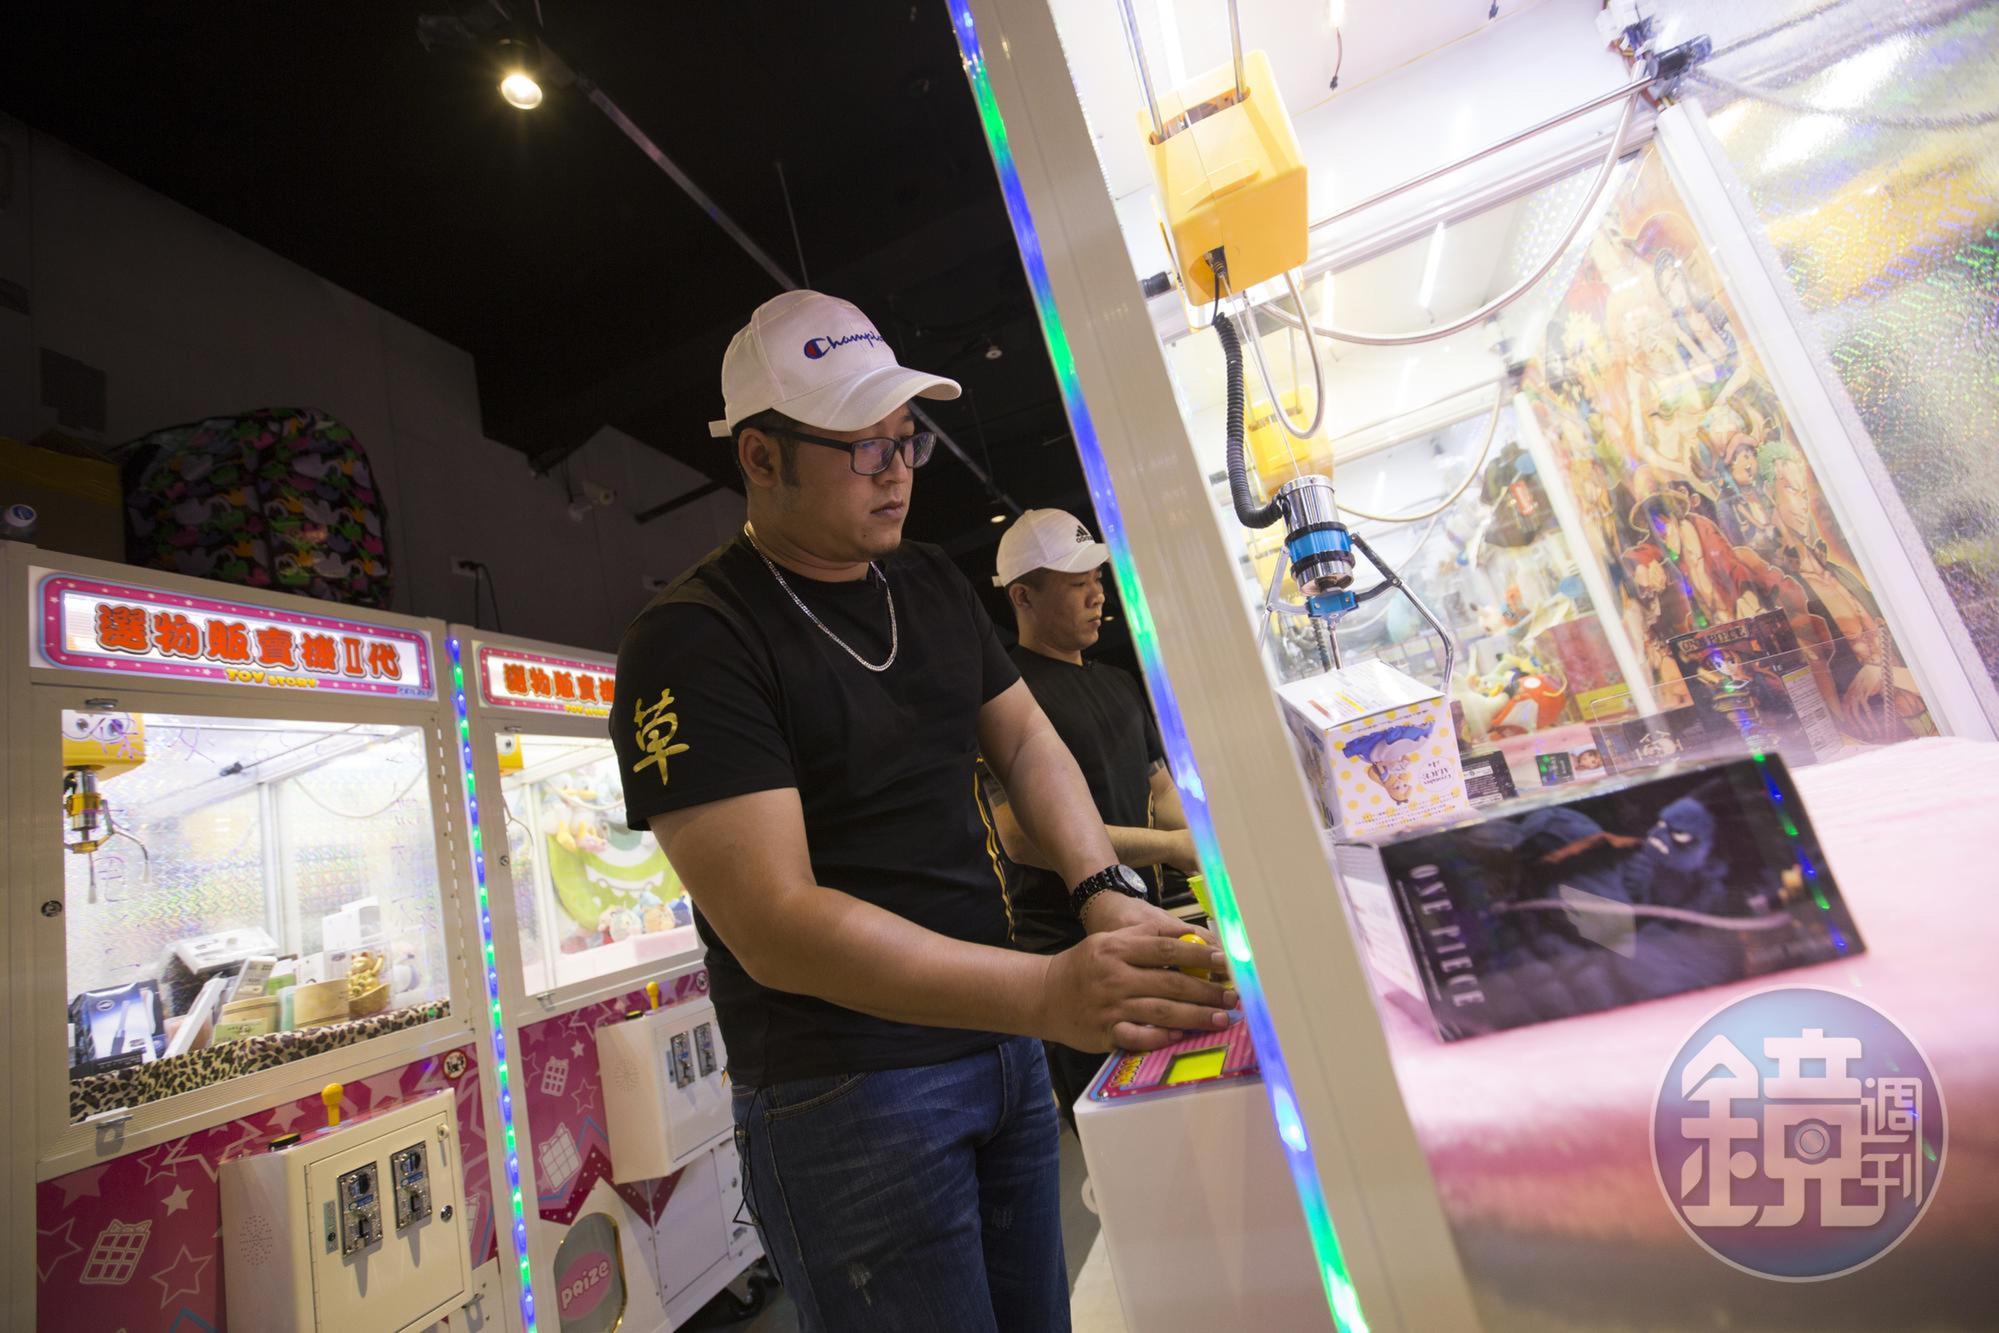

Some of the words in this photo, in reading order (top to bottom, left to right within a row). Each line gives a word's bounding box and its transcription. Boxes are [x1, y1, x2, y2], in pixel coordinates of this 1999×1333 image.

[225, 667, 265, 684] TOY
[267, 675, 317, 688] STORY
[633, 688, 690, 785] 草
[1409, 863, 1453, 916] ONE
[1430, 924, 1486, 1008] PIECE
